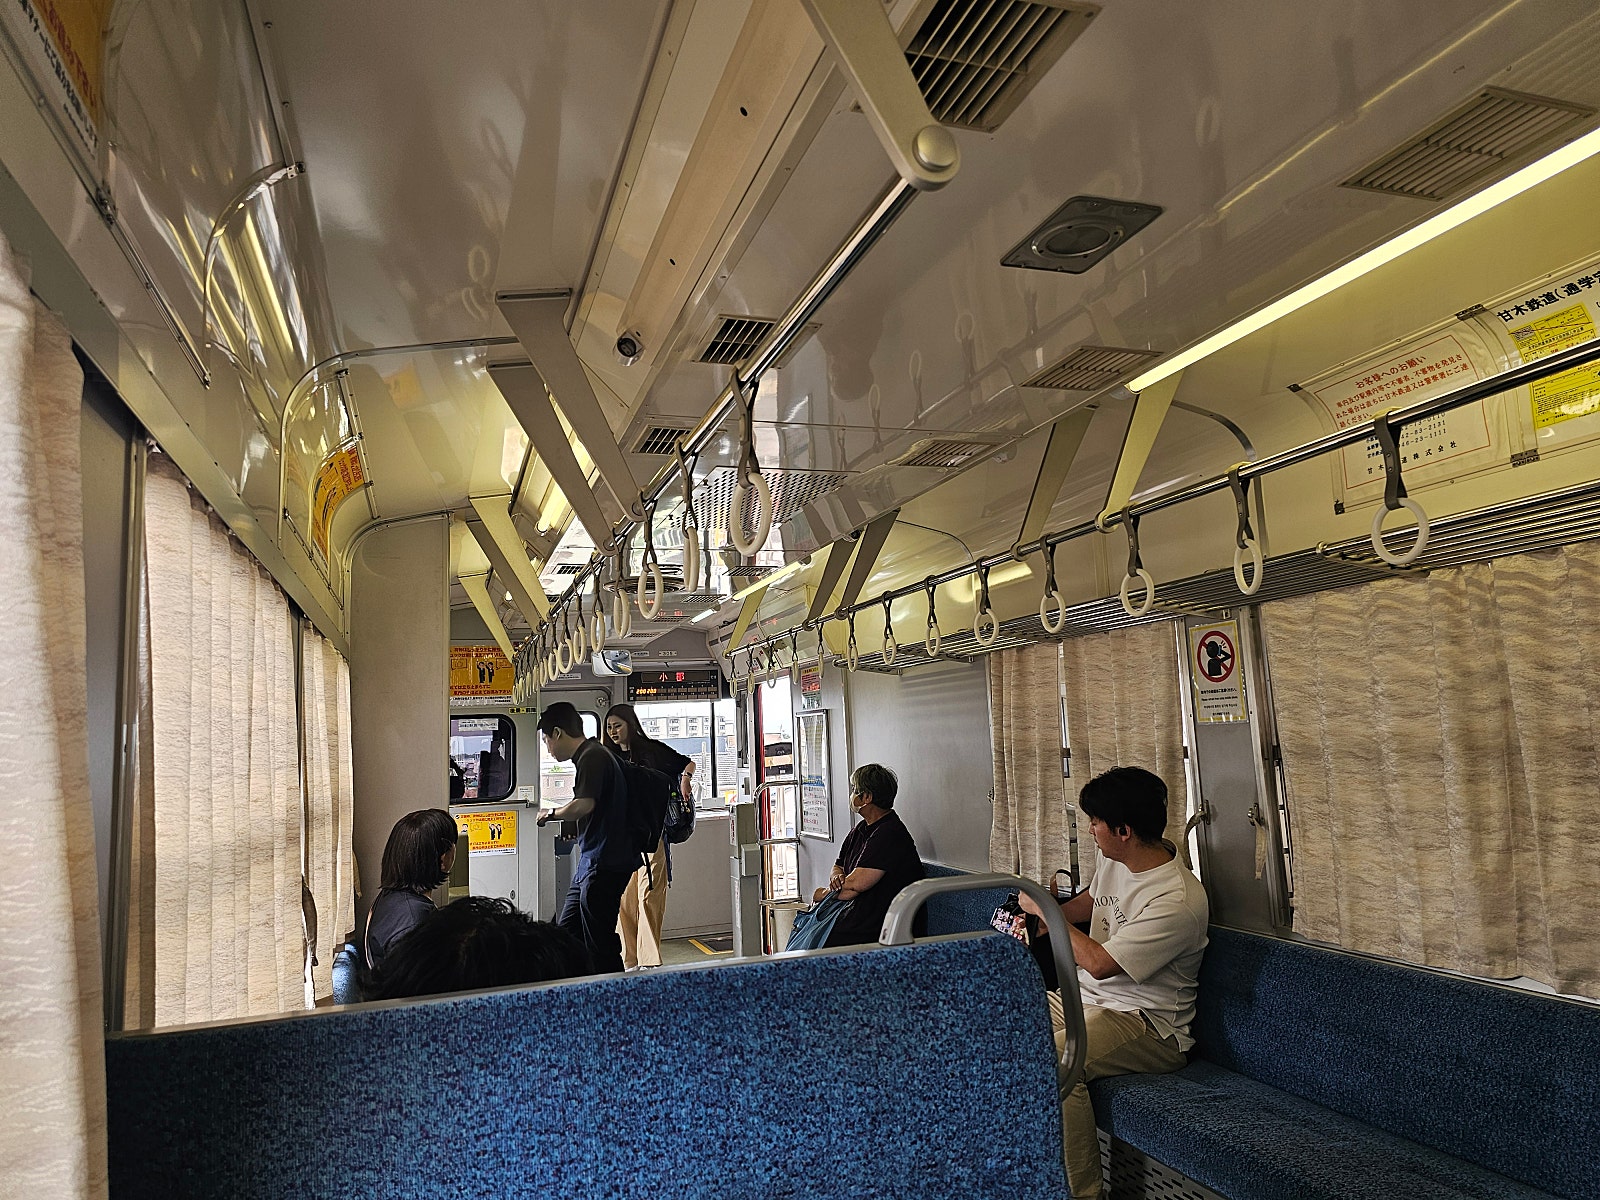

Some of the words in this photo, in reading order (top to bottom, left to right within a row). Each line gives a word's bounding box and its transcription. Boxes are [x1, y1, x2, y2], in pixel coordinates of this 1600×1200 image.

[1355, 355, 1426, 388] お客様へのお願い
